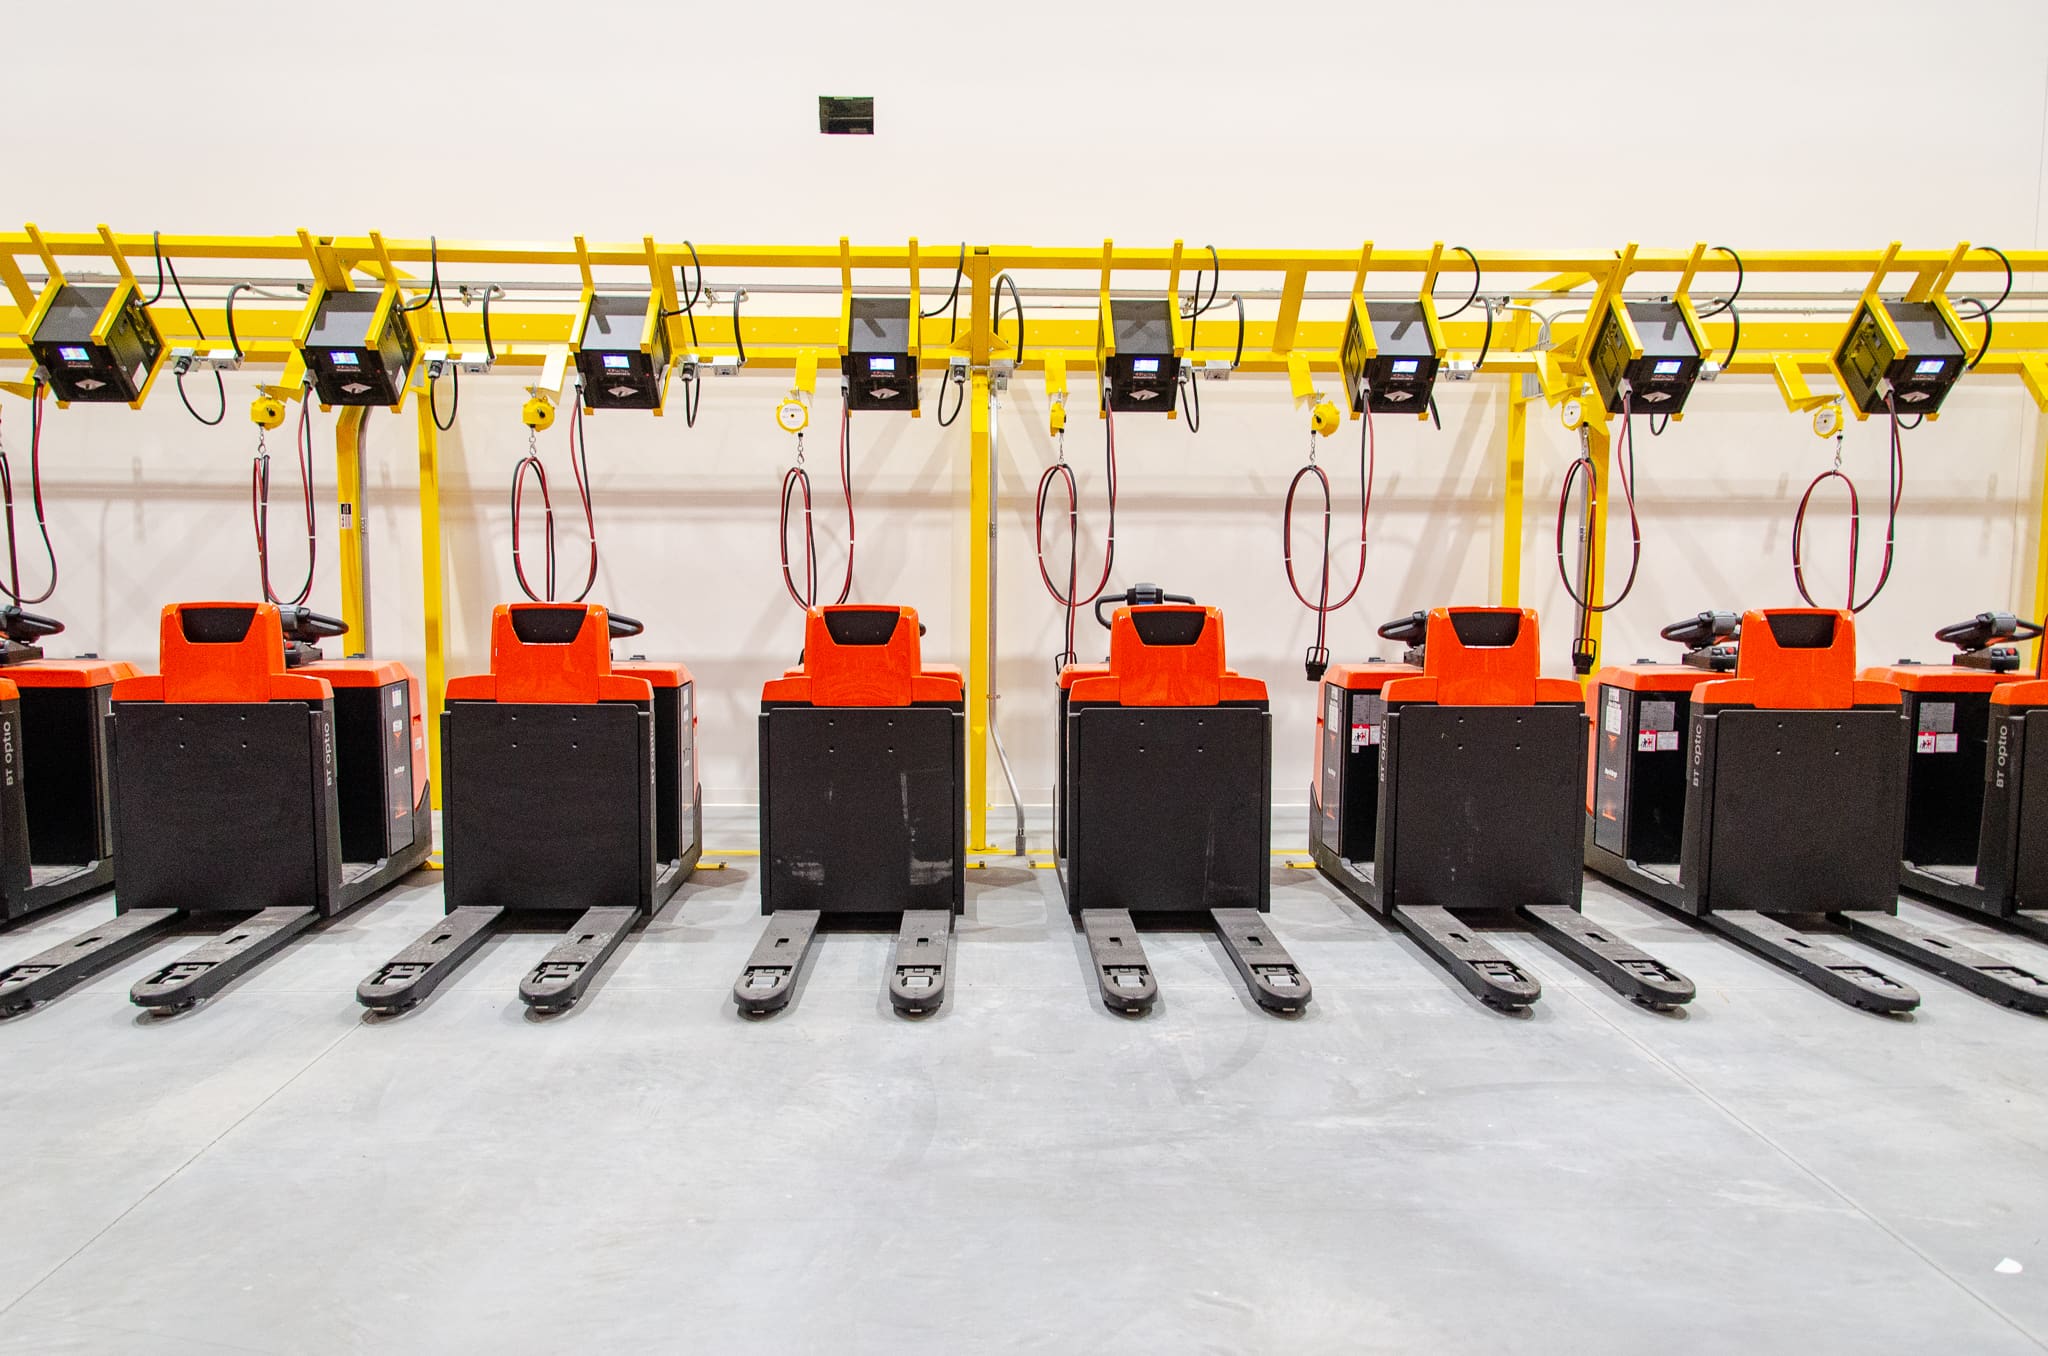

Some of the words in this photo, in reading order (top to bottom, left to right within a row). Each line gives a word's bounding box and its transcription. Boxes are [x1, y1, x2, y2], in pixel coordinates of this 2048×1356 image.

[3, 721, 14, 764] optio
[324, 722, 332, 764] optio
[1381, 719, 1389, 760] optio
[1694, 724, 1702, 765] optio
[1997, 725, 2008, 766] optio
[6, 768, 14, 786] BT
[326, 769, 332, 786] BT
[1380, 763, 1386, 782] BT
[1693, 768, 1700, 787] BT
[1996, 770, 2005, 788] BT
